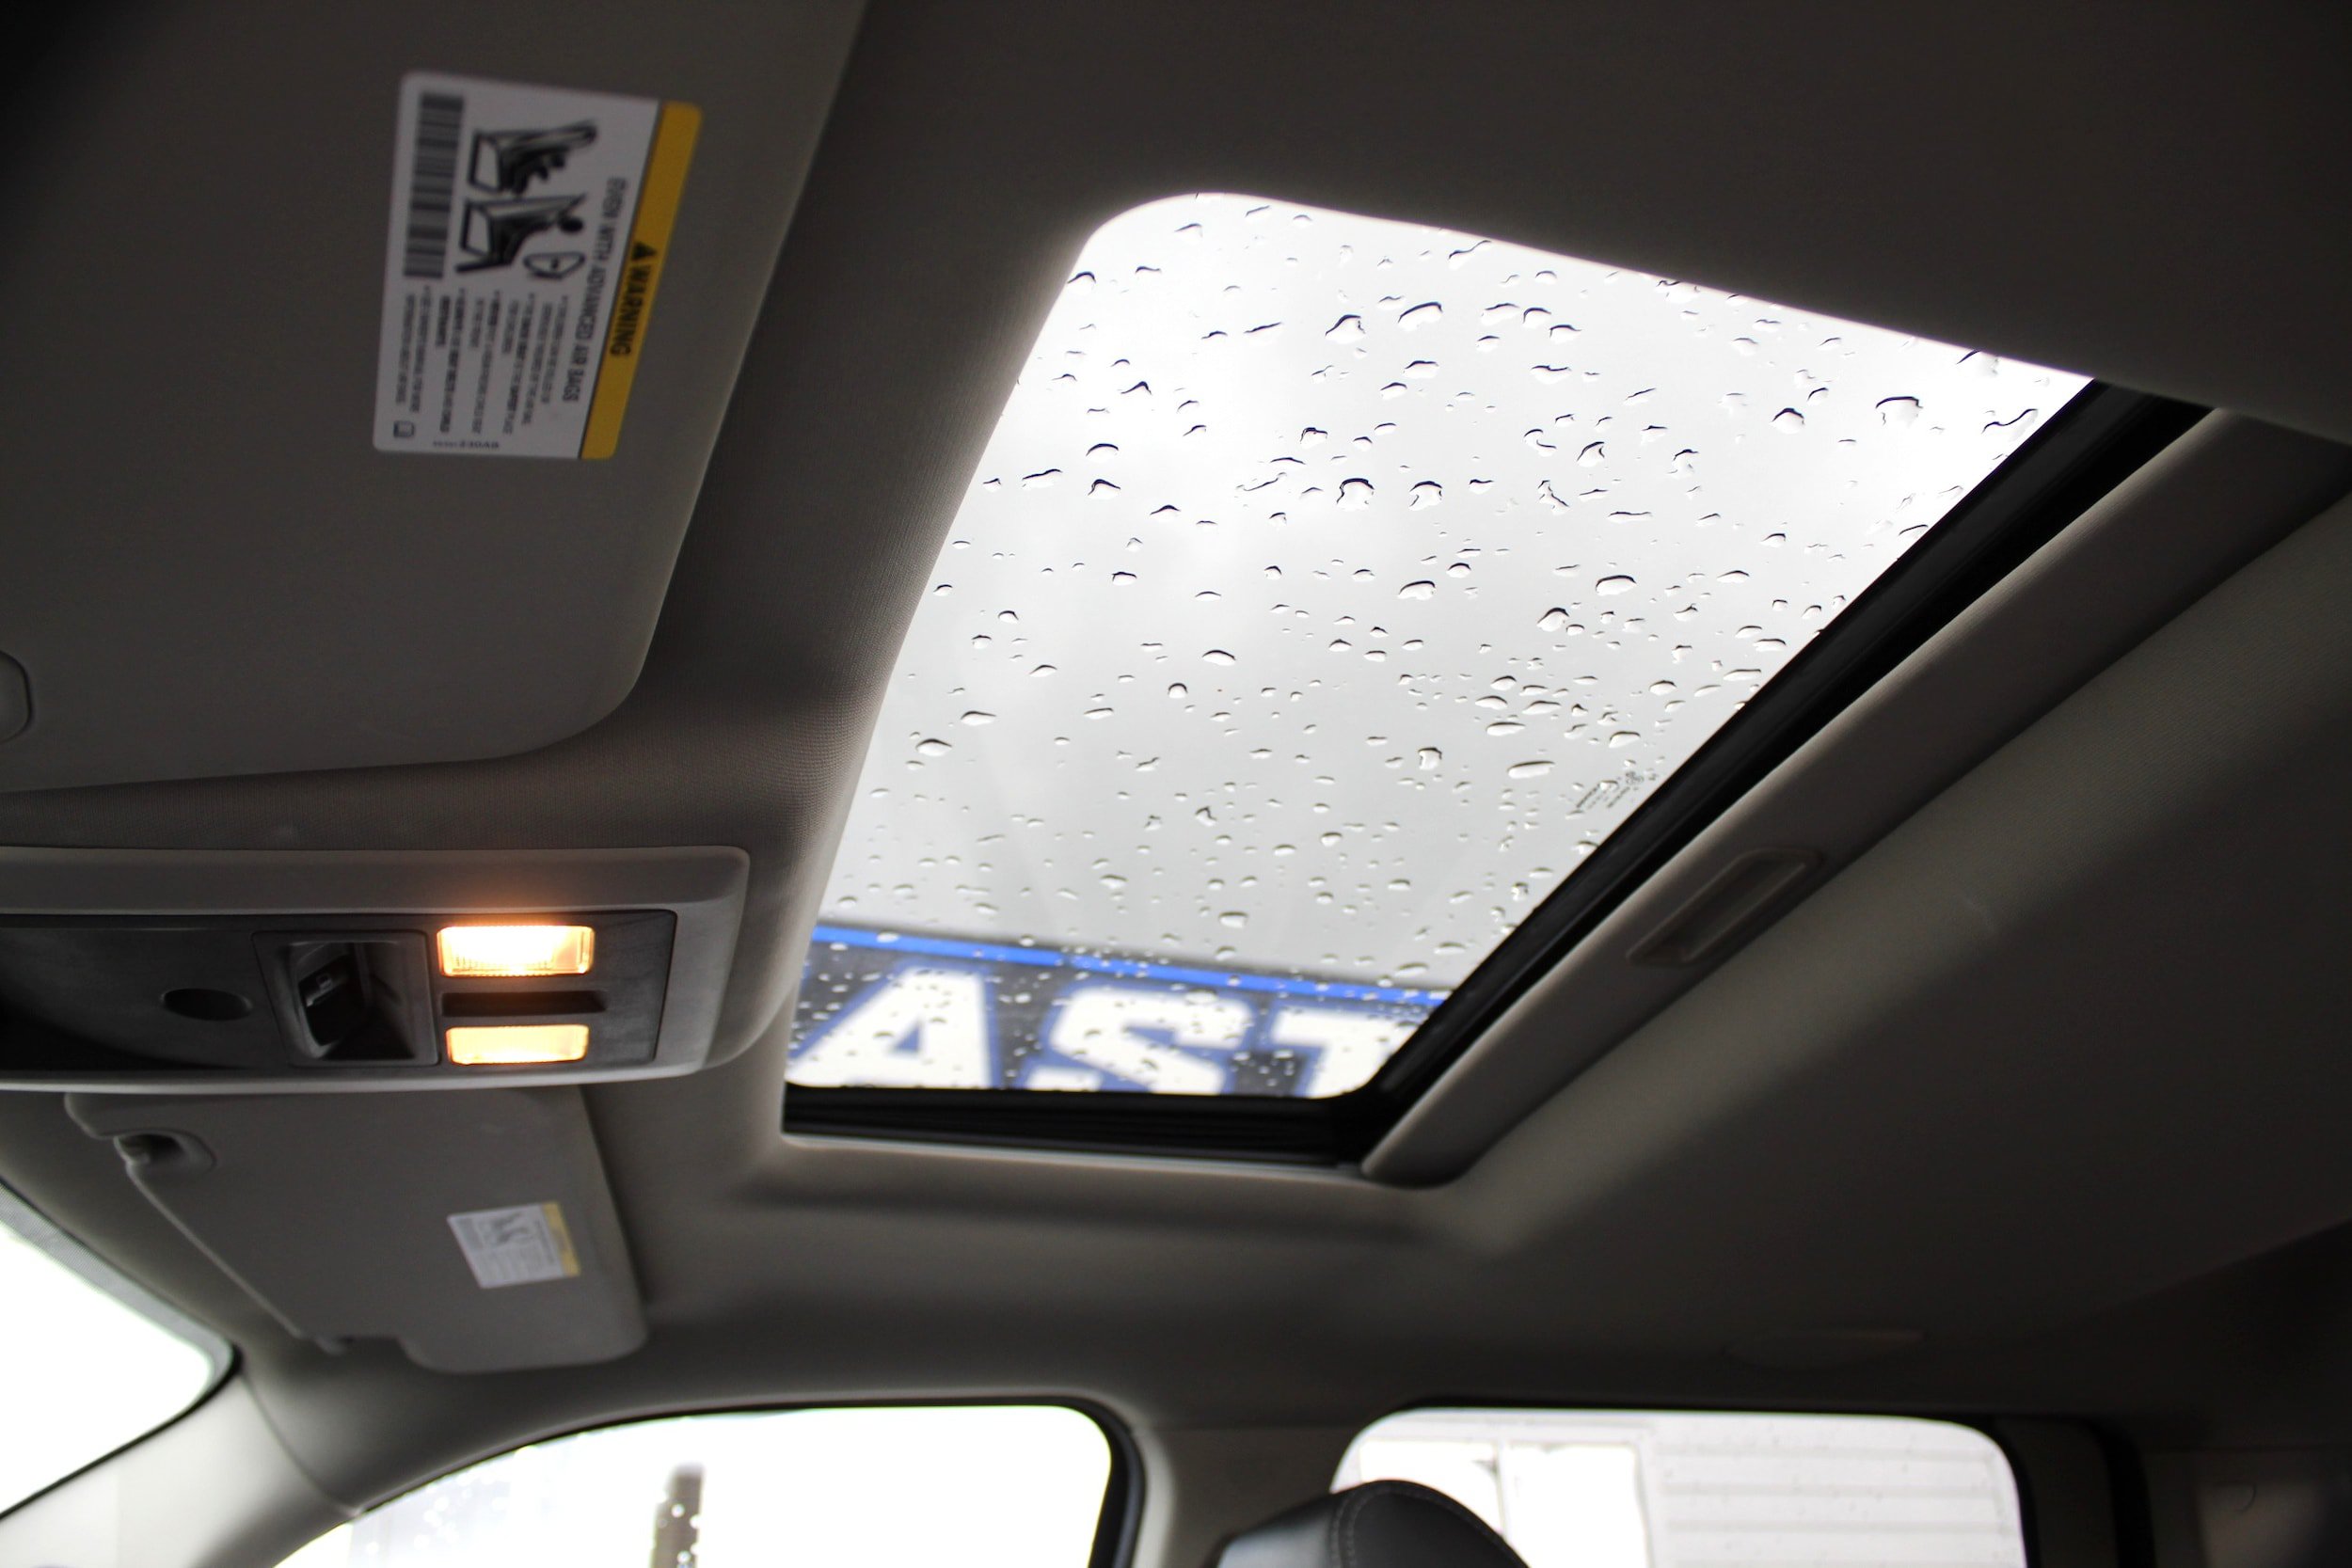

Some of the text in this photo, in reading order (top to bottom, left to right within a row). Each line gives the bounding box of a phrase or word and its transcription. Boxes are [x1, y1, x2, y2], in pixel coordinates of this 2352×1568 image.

[562, 177, 628, 403] EVEN WITH ADVANCED AIR BAGS
[611, 266, 651, 356] WARNING
